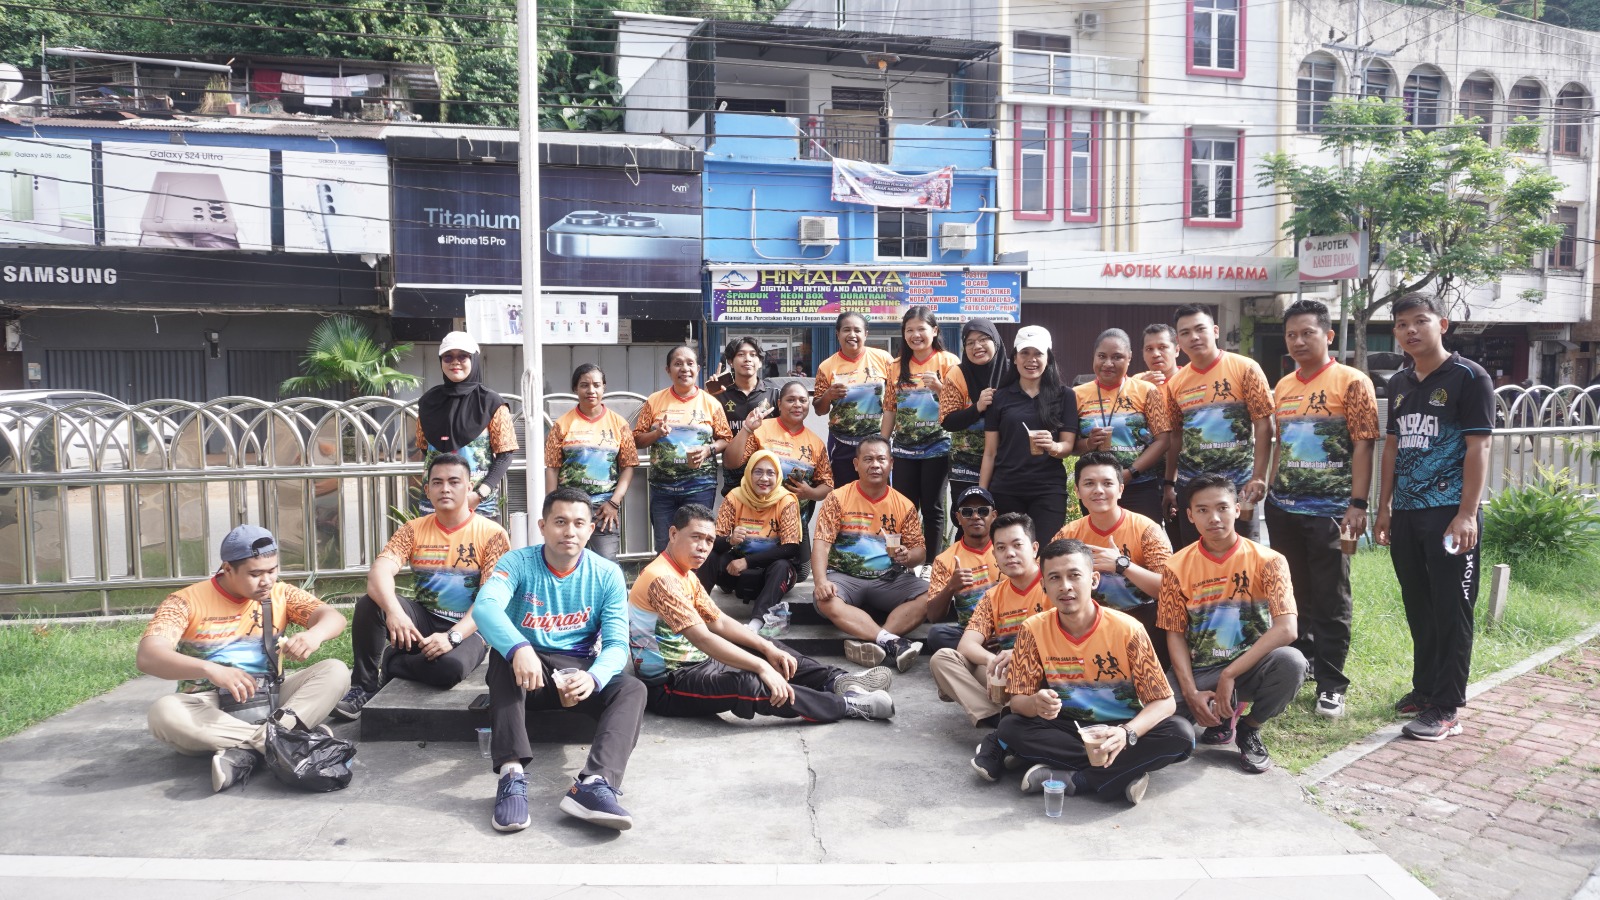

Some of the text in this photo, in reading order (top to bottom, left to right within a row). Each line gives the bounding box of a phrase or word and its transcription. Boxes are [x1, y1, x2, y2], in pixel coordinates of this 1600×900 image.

[150, 150, 183, 160] Galaxy
[424, 208, 520, 229] Titanium
[446, 235, 506, 246] iPhone 15 Pro
[1317, 239, 1348, 251] APOTEK
[1312, 252, 1355, 268] KASIH FARMA
[3, 266, 117, 284] SAMSUNG
[1101, 263, 1268, 280] APOTEK KASIH FARMA
[522, 607, 591, 632] Imigrasi
